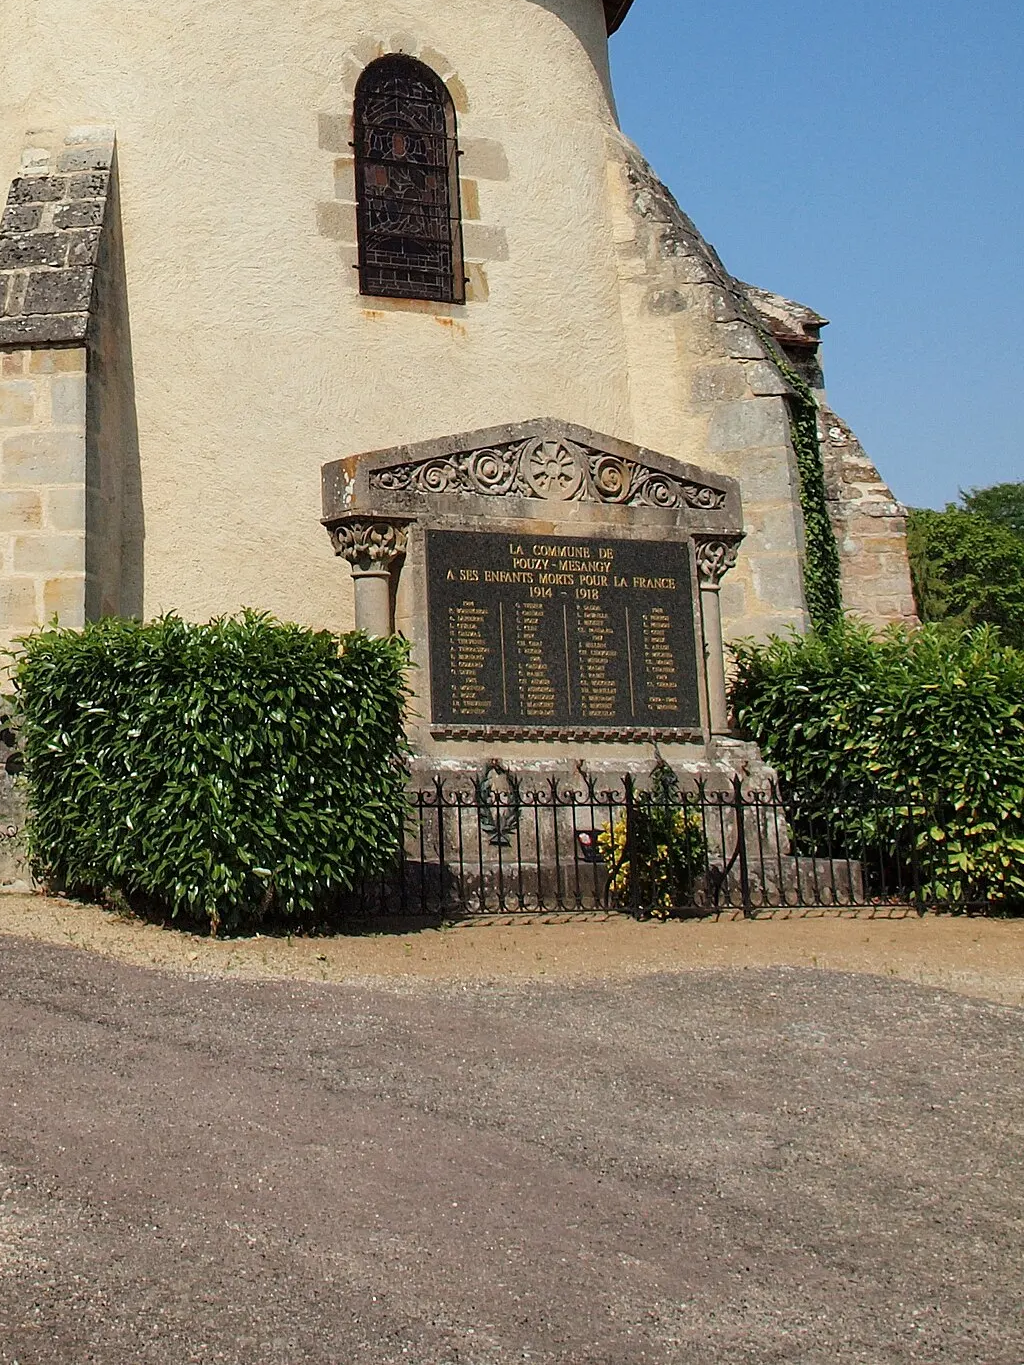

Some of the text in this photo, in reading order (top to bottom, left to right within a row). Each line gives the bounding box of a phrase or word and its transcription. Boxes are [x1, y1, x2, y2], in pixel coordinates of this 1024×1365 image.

[510, 544, 613, 559] LA COMMUNE DE
[447, 570, 675, 589] A SES ENFANTS MORTS POUR LA FRANCE
[529, 587, 552, 597] 1914
[575, 589, 599, 599] 1918
